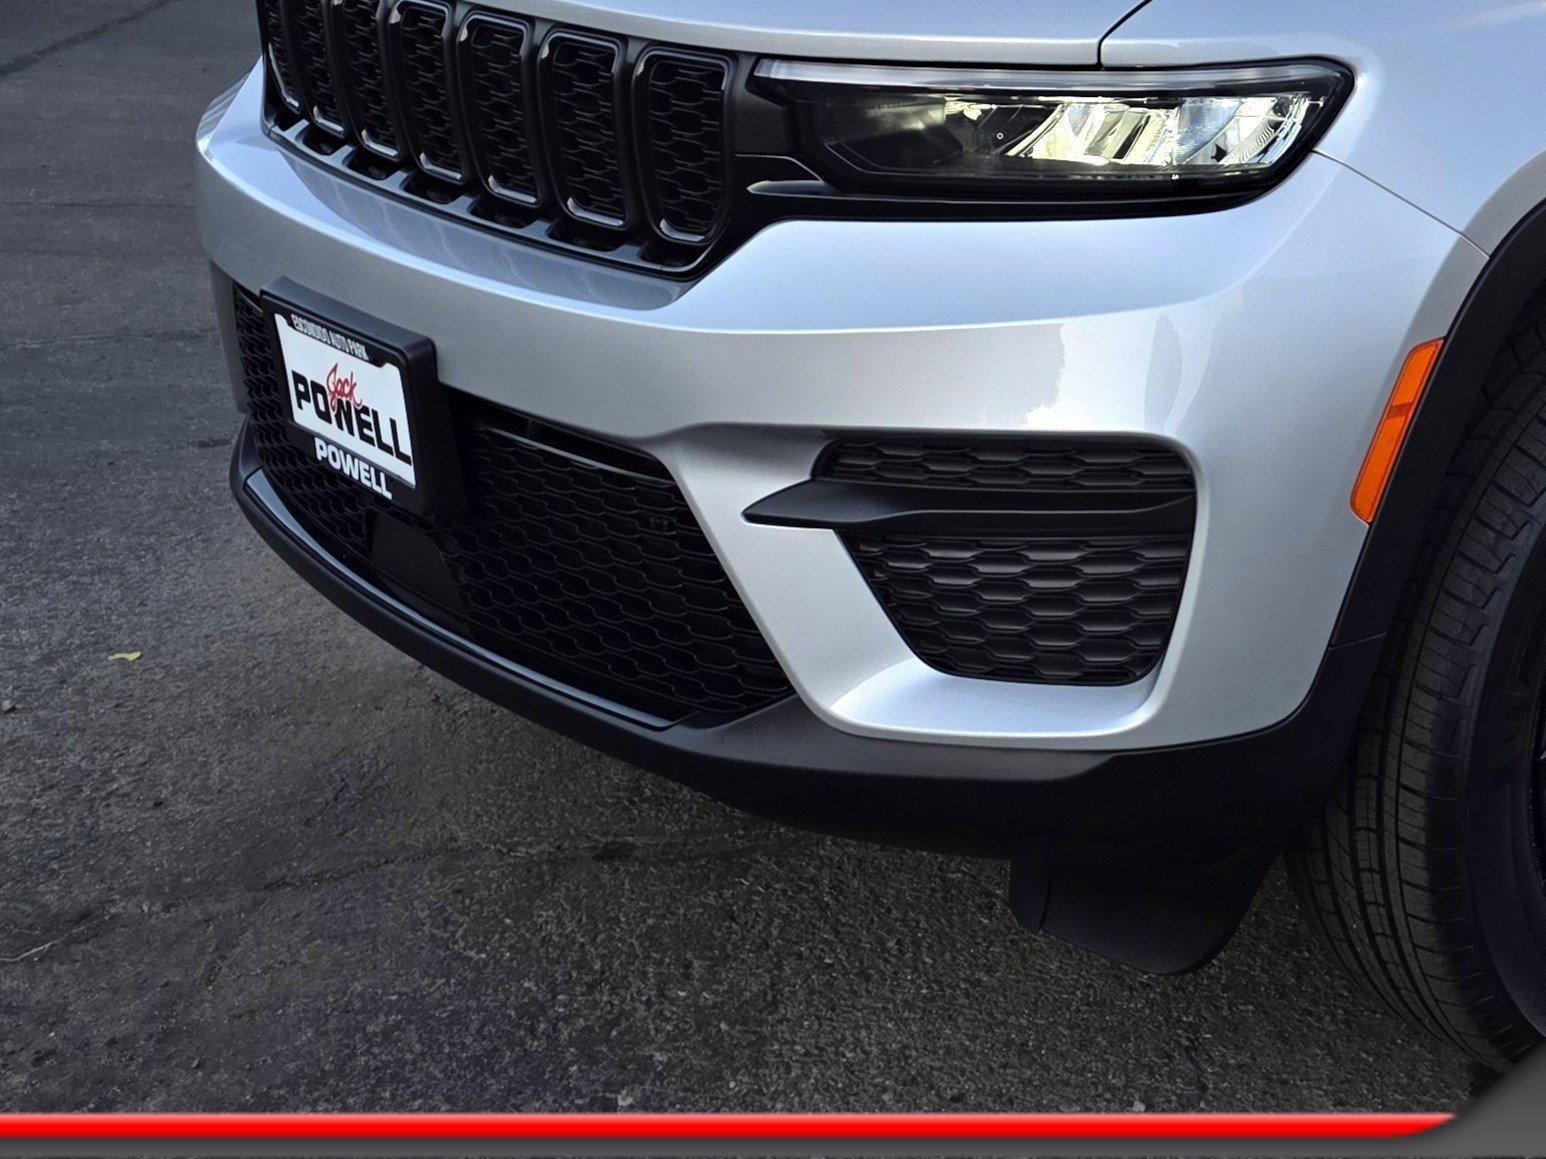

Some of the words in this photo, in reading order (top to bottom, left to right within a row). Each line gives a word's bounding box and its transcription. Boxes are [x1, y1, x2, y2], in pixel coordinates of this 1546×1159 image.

[291, 370, 412, 466] POWELL
[326, 363, 363, 412] Jack
[314, 437, 392, 500] POWELL
